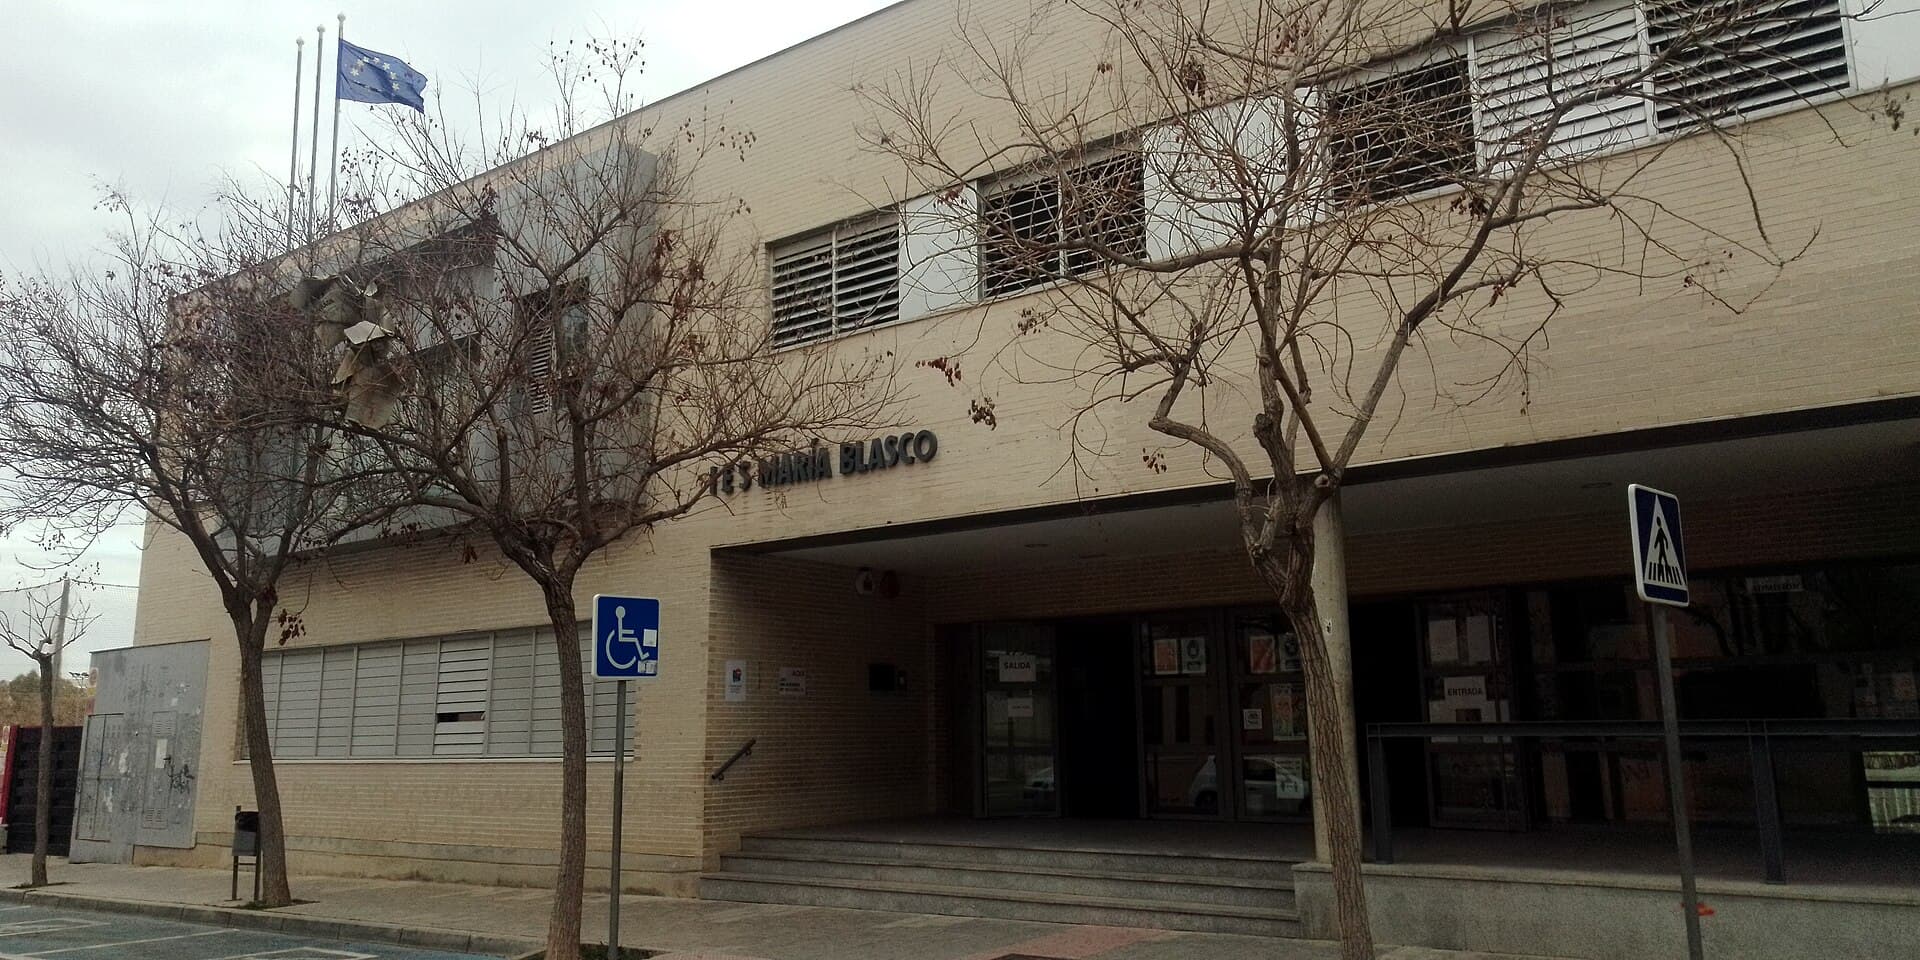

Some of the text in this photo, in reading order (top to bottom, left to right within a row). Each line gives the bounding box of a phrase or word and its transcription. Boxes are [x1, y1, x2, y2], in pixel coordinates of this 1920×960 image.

[839, 429, 938, 475] BLASCO
[1003, 661, 1031, 670] SALIDA
[1447, 687, 1484, 697] ENTRADA
